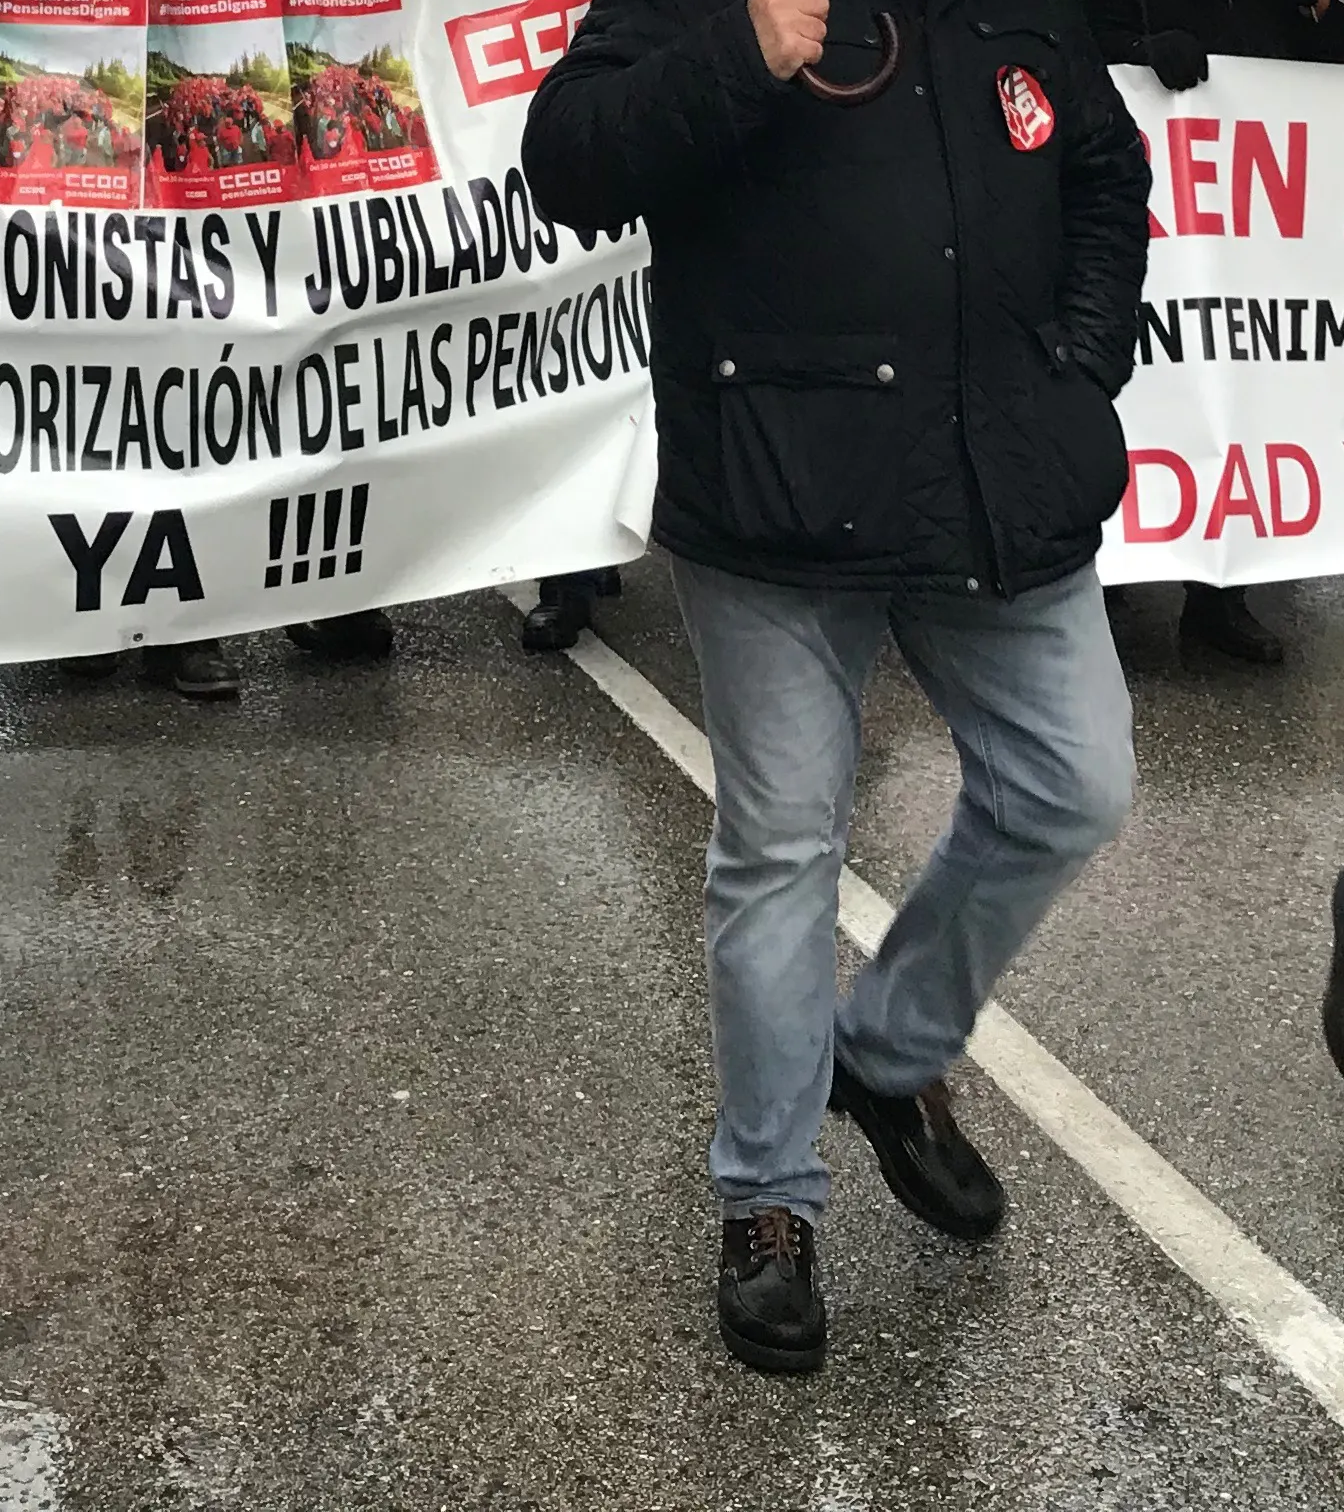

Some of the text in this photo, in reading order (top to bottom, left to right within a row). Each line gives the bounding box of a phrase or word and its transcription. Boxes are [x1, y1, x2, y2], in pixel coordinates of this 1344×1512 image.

[65, 173, 128, 190] CCOO
[218, 169, 281, 190] CCOO
[367, 153, 415, 172] CCOO
[246, 210, 281, 318] Y
[305, 166, 559, 316] JUBILADOS
[297, 344, 365, 457] DE
[373, 322, 453, 443] LAS
[48, 508, 206, 613] YA
[263, 483, 370, 590] !!!!
